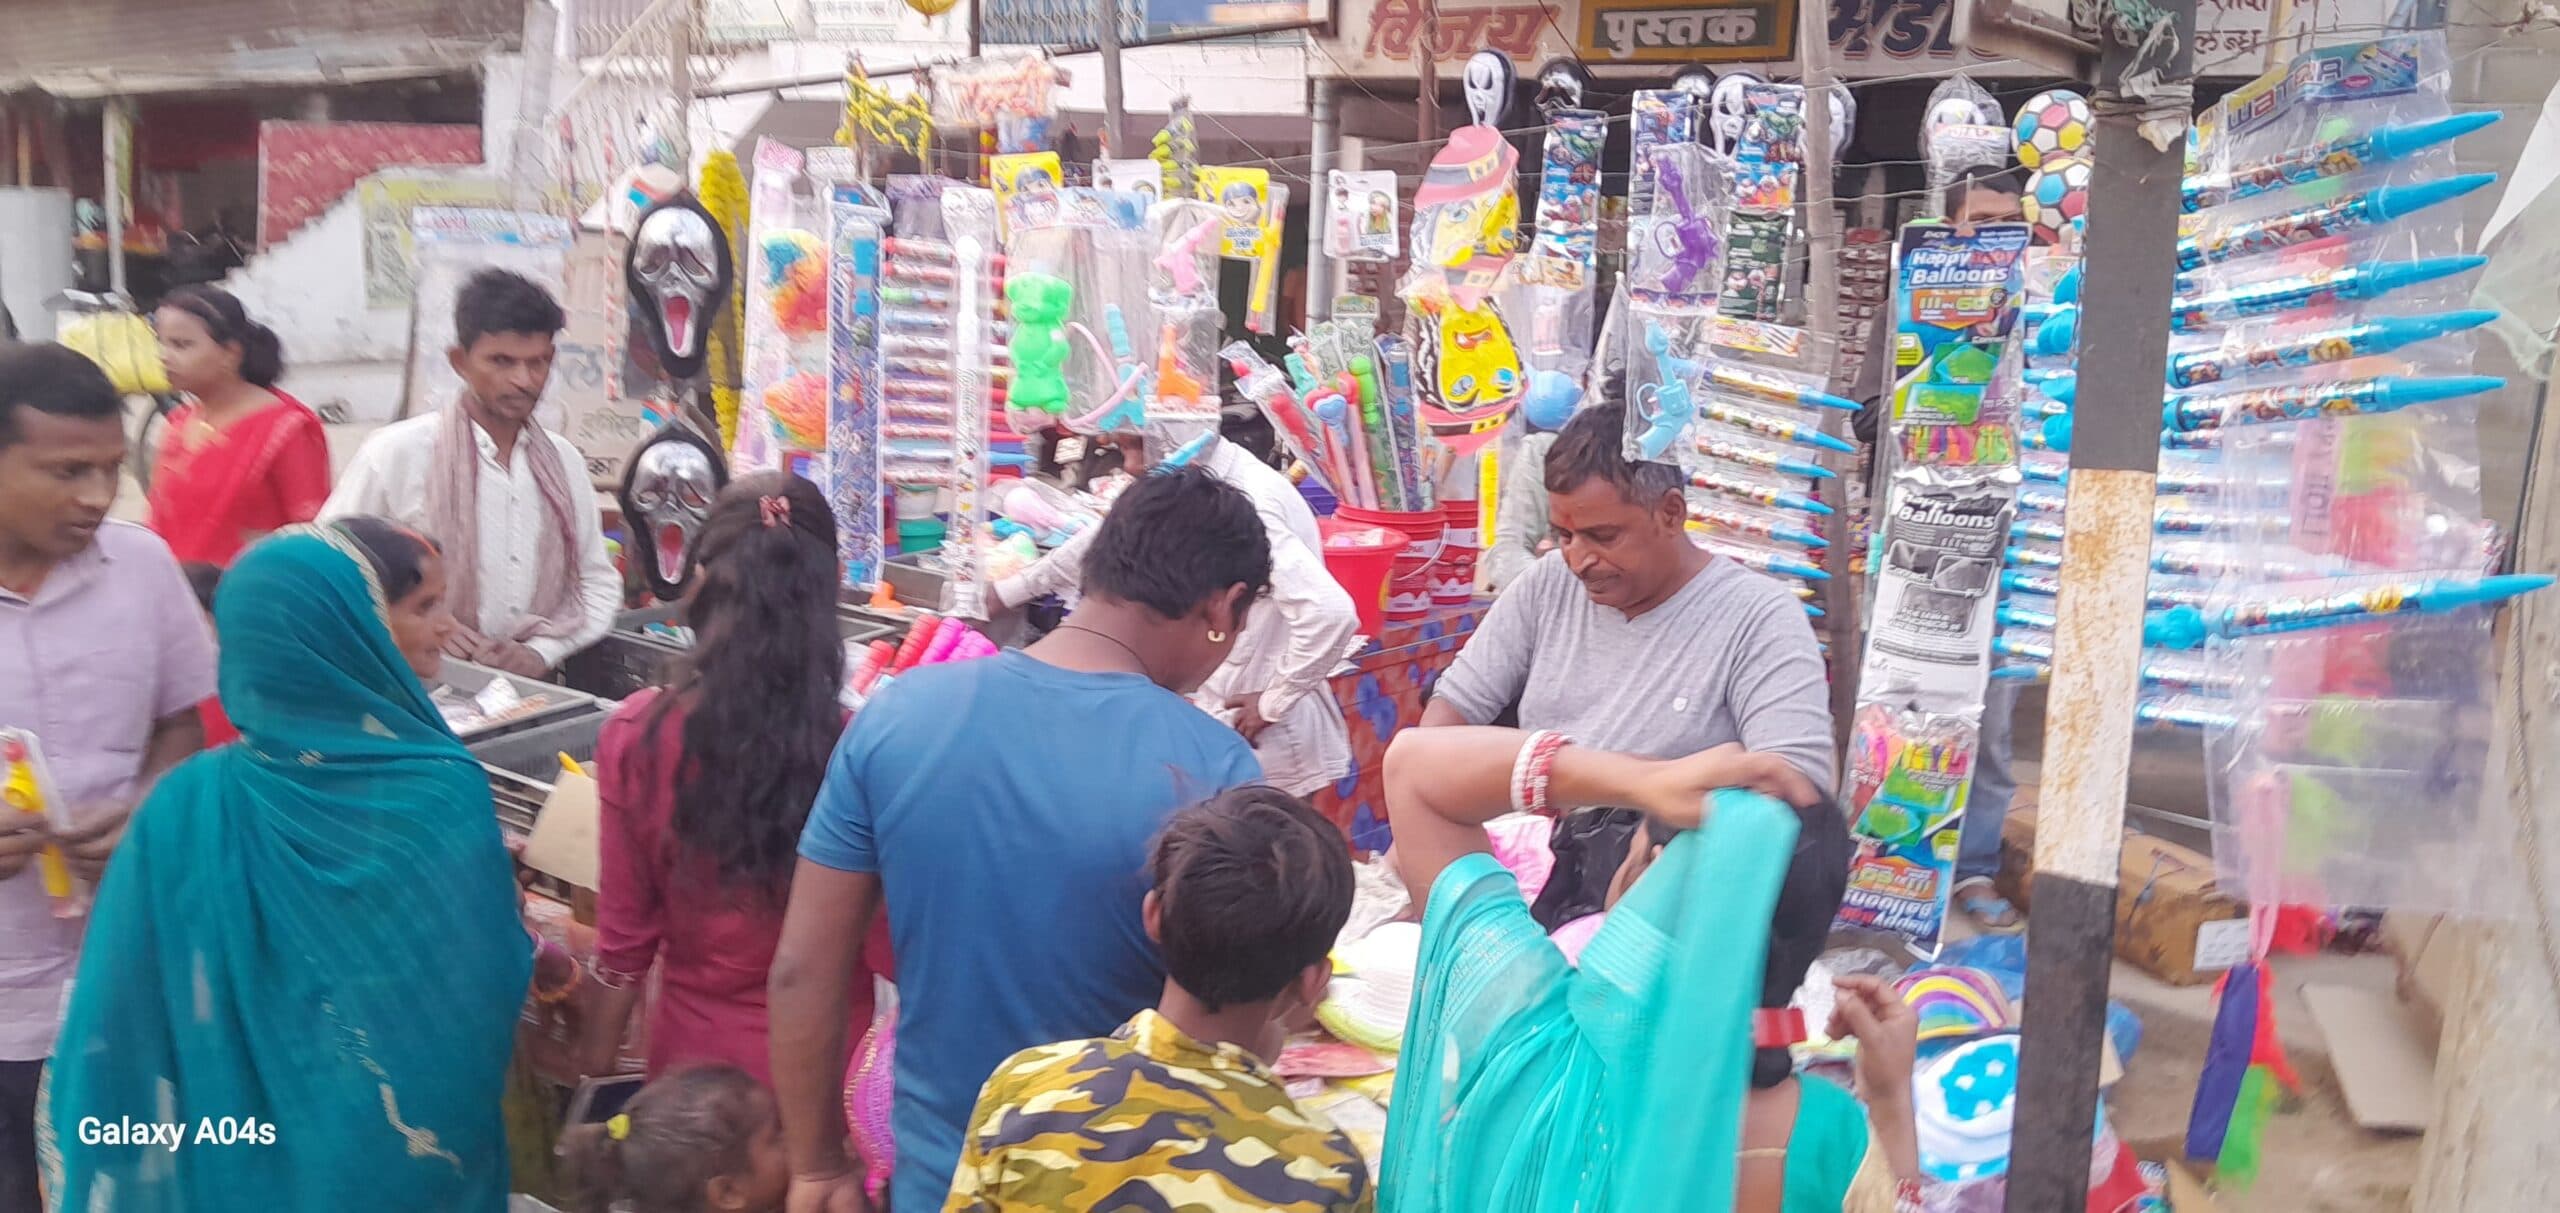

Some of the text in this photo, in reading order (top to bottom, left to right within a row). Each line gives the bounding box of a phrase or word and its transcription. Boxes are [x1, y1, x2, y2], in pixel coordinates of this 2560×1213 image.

[1363, 1, 1560, 63] विजय
[1602, 8, 1758, 59] पुस्तक
[1911, 251, 1972, 267] Happy
[1909, 266, 2009, 285] Balloons
[1900, 505, 1996, 529] Balloons
